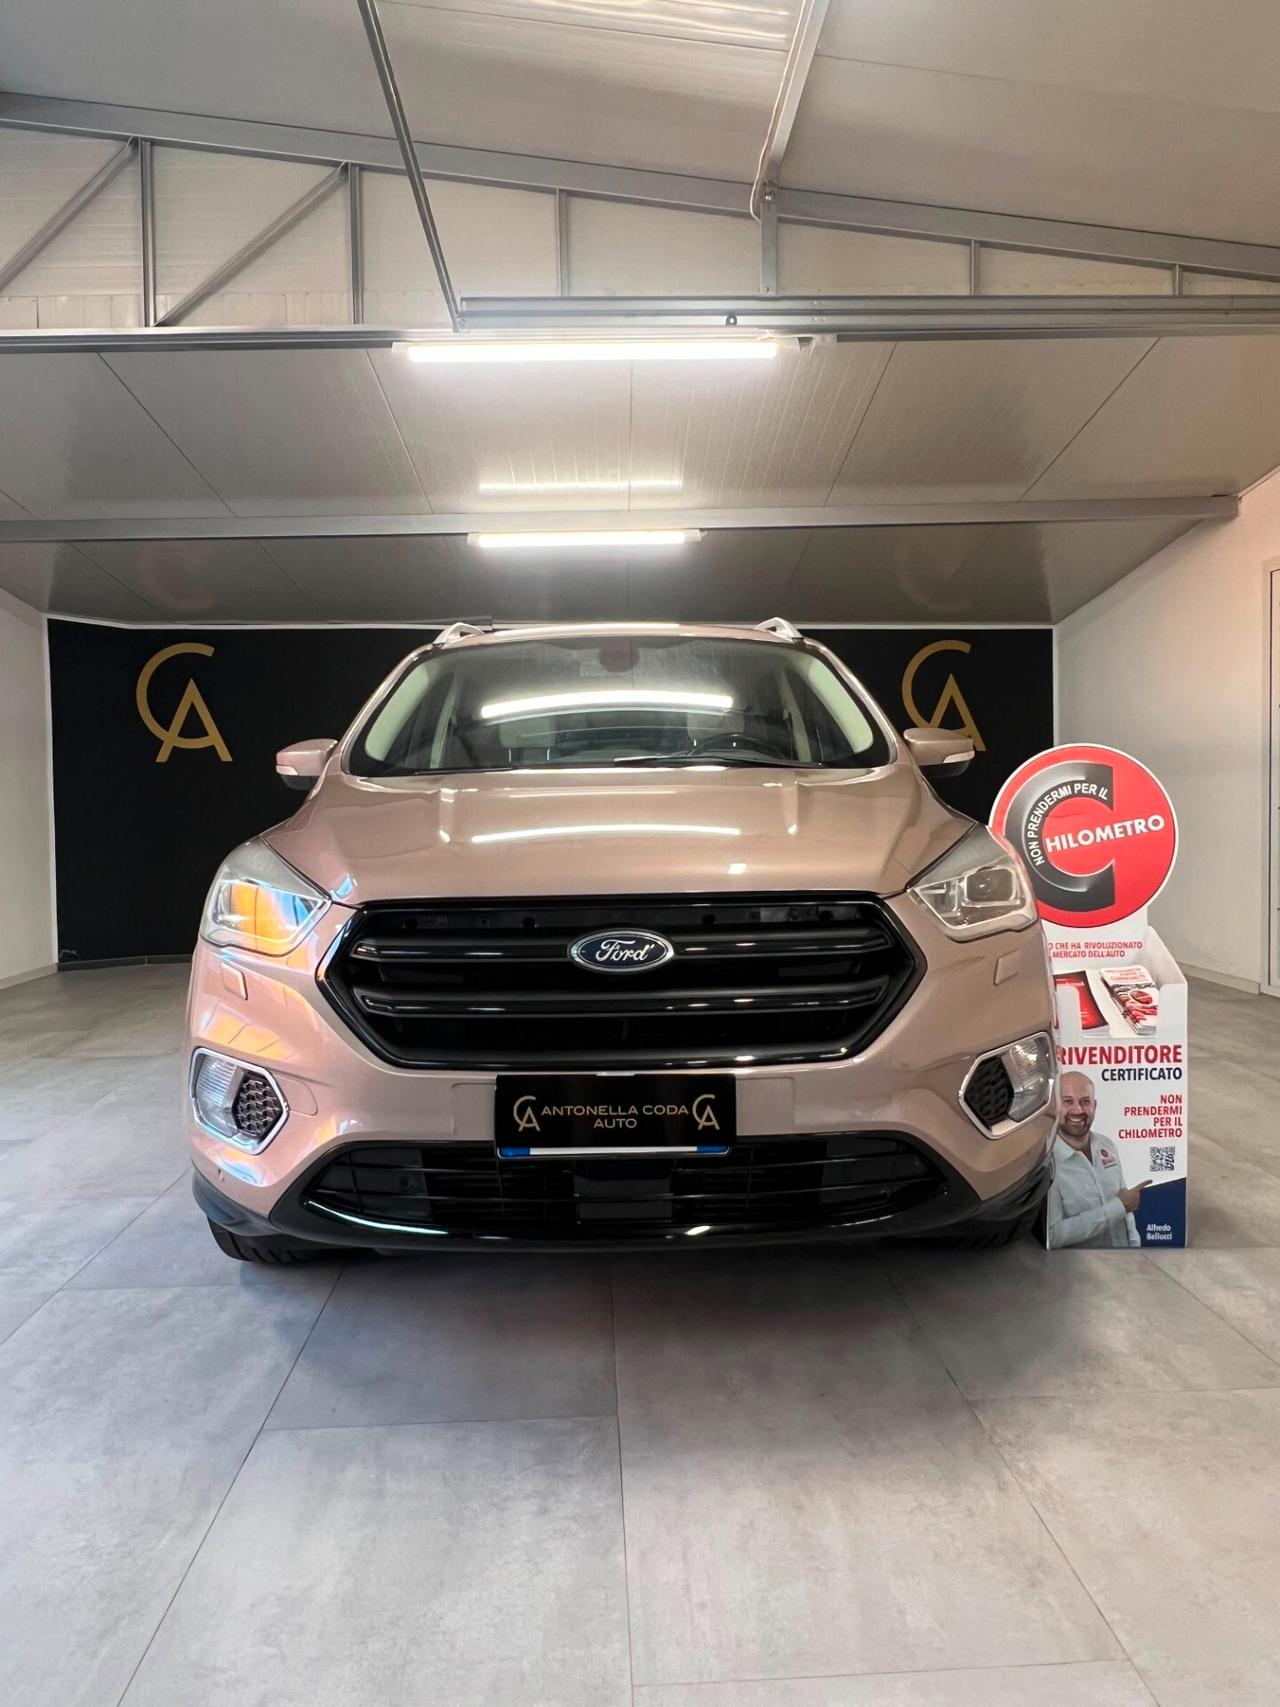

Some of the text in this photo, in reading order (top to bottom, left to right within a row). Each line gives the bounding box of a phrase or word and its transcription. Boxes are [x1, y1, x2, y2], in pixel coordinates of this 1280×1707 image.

[1027, 782, 1109, 866] NON PRENDERMI PER IL
[595, 939, 655, 962] Ford
[1055, 942, 1069, 950] CHE
[1071, 942, 1081, 950] HA
[1084, 941, 1143, 949] RIVOLUZIONATO
[1052, 950, 1087, 959] MERCATO
[1101, 1067, 1183, 1081] CERTIFICATO
[1160, 1095, 1182, 1104] NON
[540, 1104, 689, 1116] ANTONELLA CODA
[1124, 1106, 1182, 1116] PRENDERMI
[593, 1118, 638, 1129] AUTO
[1153, 1117, 1183, 1127] PER IL
[1118, 1128, 1183, 1139] CHILOMETRO
[1146, 1232, 1173, 1240] Bellucci
